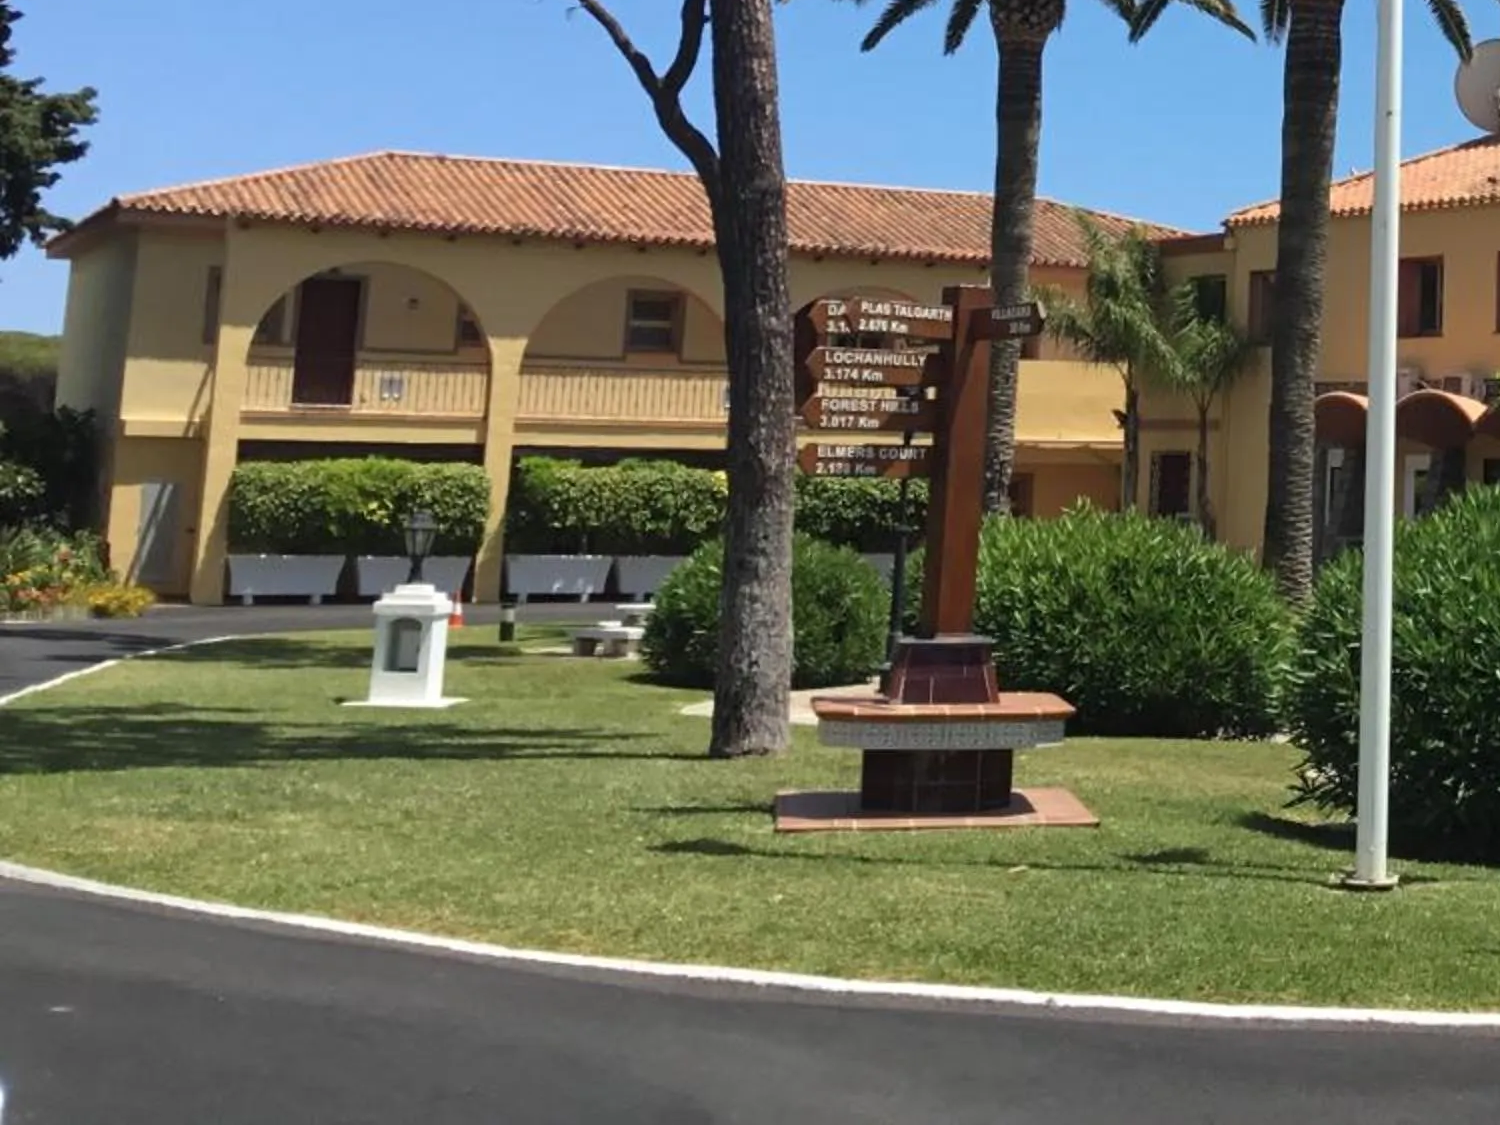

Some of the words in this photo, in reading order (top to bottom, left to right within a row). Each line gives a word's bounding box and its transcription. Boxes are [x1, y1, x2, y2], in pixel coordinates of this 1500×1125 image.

[890, 320, 909, 333] Km
[825, 350, 927, 367] LOCHANHULLY
[862, 368, 883, 381] Km
[821, 398, 875, 412] FOREST
[880, 399, 919, 414] HILLS
[857, 416, 880, 428] Km
[817, 445, 874, 458] ELMERS
[878, 447, 926, 460] COURT
[855, 463, 877, 475] Km
